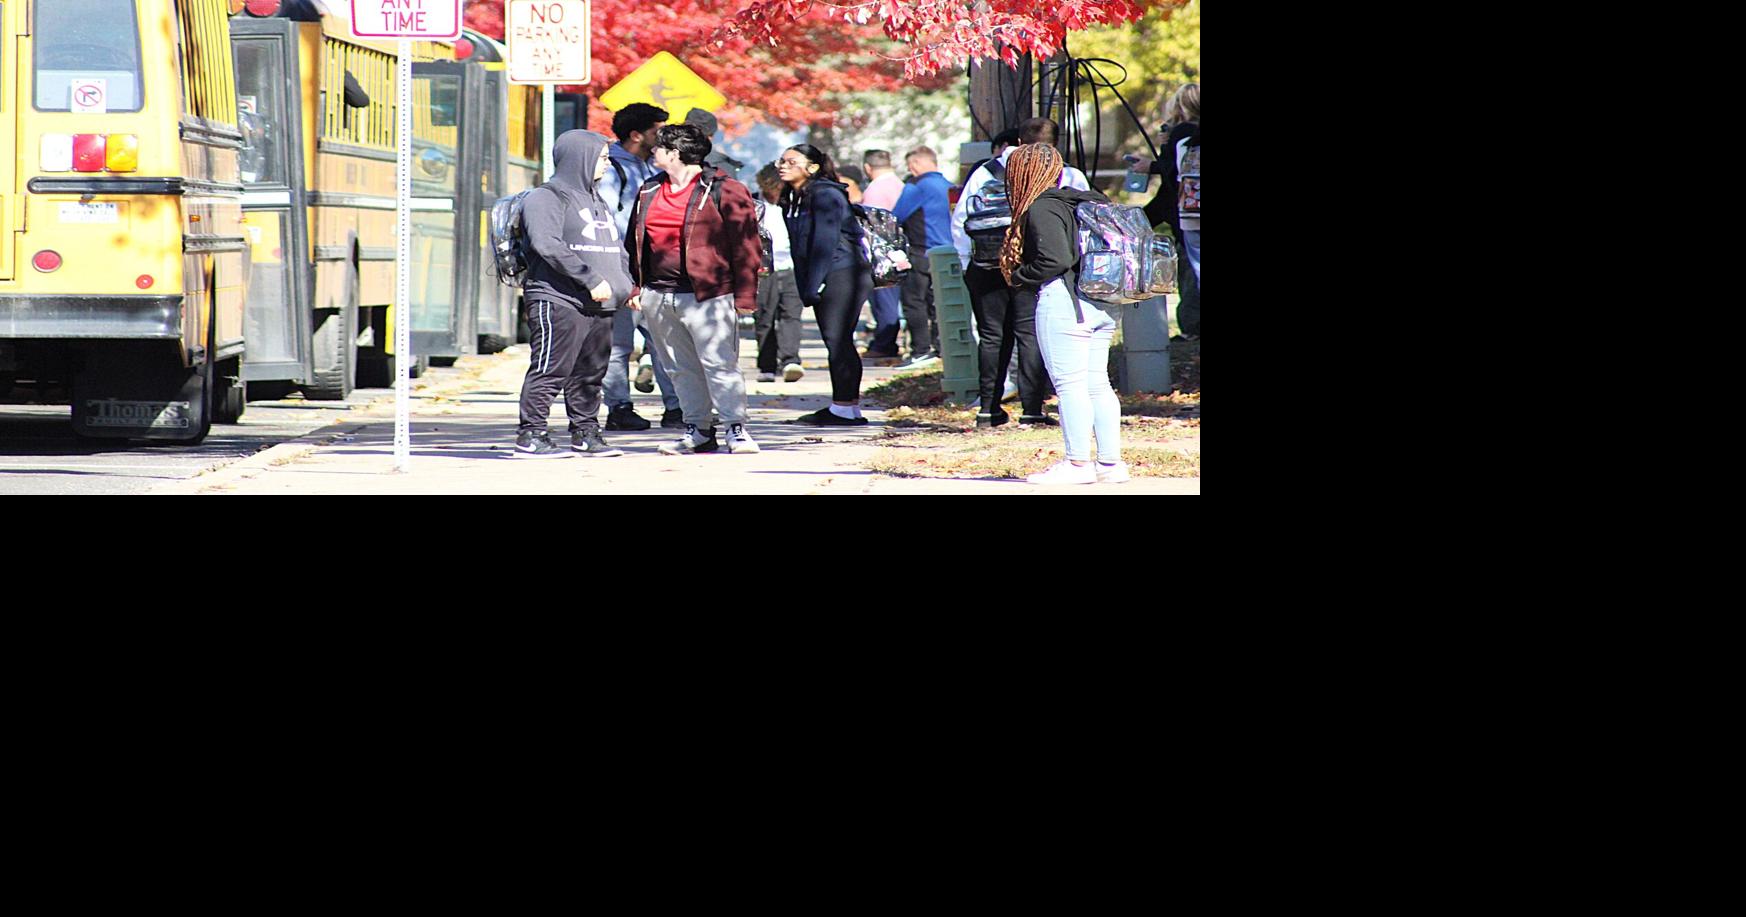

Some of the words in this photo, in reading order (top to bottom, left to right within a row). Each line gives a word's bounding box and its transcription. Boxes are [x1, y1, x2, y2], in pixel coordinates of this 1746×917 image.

[380, 11, 427, 31] TIME
[530, 3, 564, 24] NO
[516, 26, 579, 44] PARKNG
[532, 63, 563, 77] TME
[97, 397, 179, 418] Thomas
